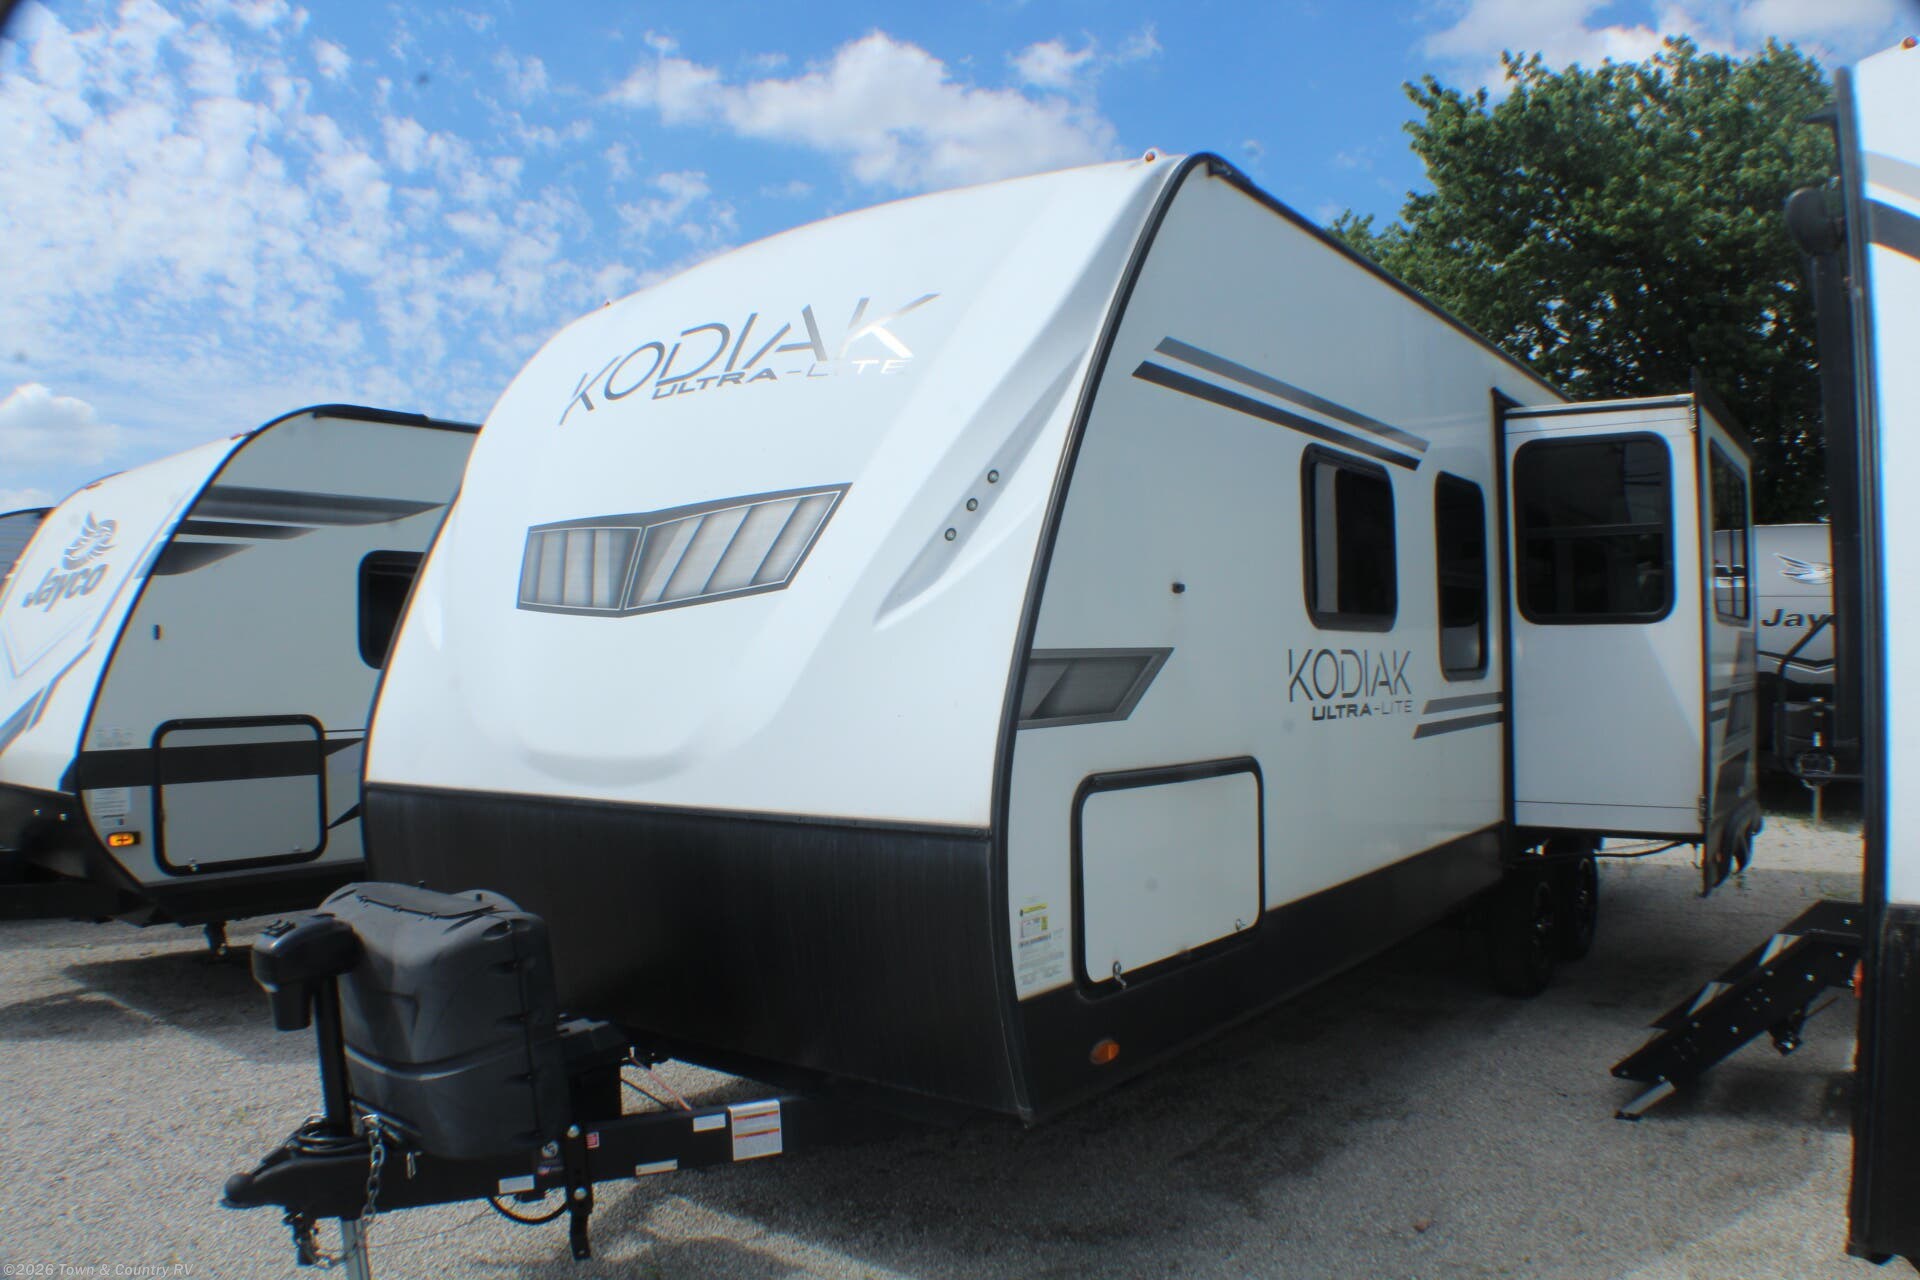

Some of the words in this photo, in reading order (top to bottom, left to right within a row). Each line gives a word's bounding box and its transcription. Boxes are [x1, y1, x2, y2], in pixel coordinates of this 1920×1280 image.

[559, 293, 940, 426] KODIAK
[652, 358, 912, 401] ULTRA-LTE
[21, 564, 110, 612] Jayco
[1288, 648, 1412, 702] KODIAK
[1312, 700, 1413, 721] ULTRA-LITE
